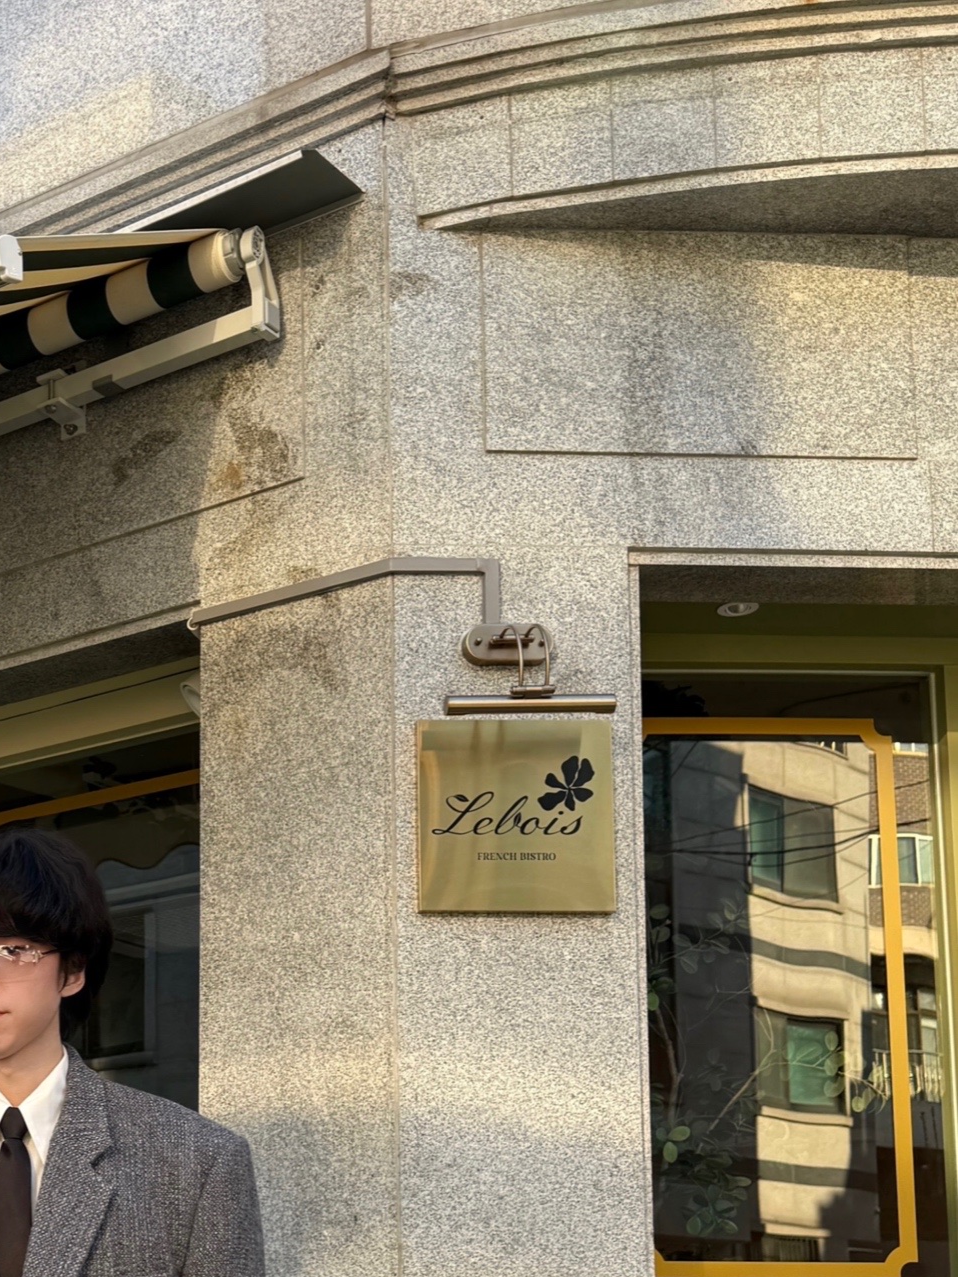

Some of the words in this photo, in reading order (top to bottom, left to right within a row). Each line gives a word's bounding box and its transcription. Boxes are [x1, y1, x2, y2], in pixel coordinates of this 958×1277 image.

[432, 791, 584, 836] Lebois
[477, 851, 518, 862] FRENCH
[519, 851, 557, 862] BISTRO
